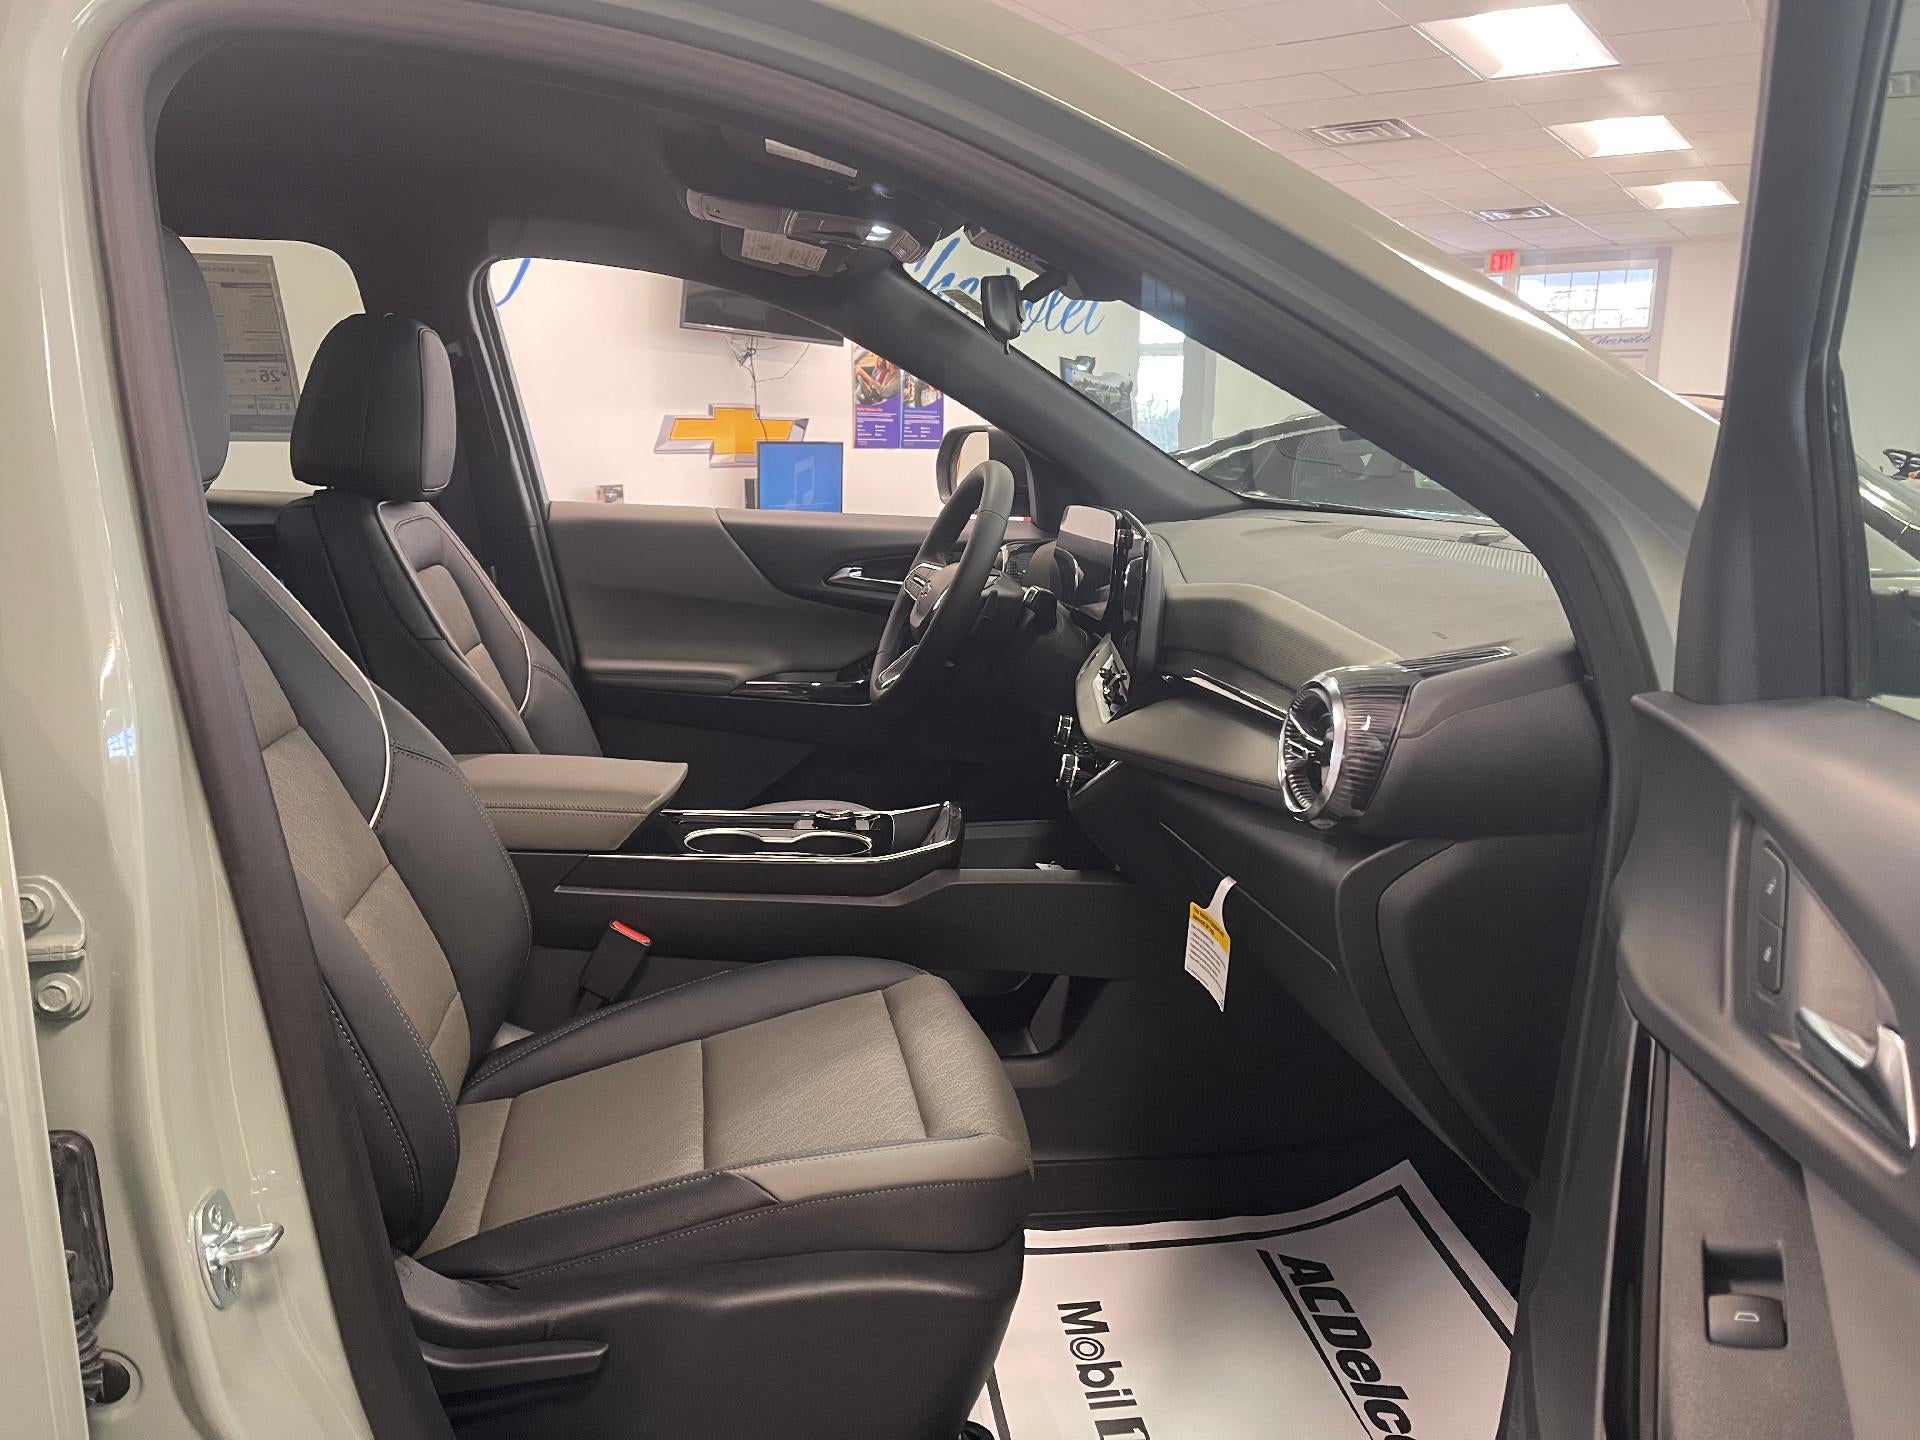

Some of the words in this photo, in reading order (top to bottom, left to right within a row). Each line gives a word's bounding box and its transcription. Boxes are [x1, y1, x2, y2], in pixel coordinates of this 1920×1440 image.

[1489, 250, 1516, 272] EXIT
[1056, 1300, 1138, 1411] Mobil
[1278, 1253, 1416, 1440] ACDelc
